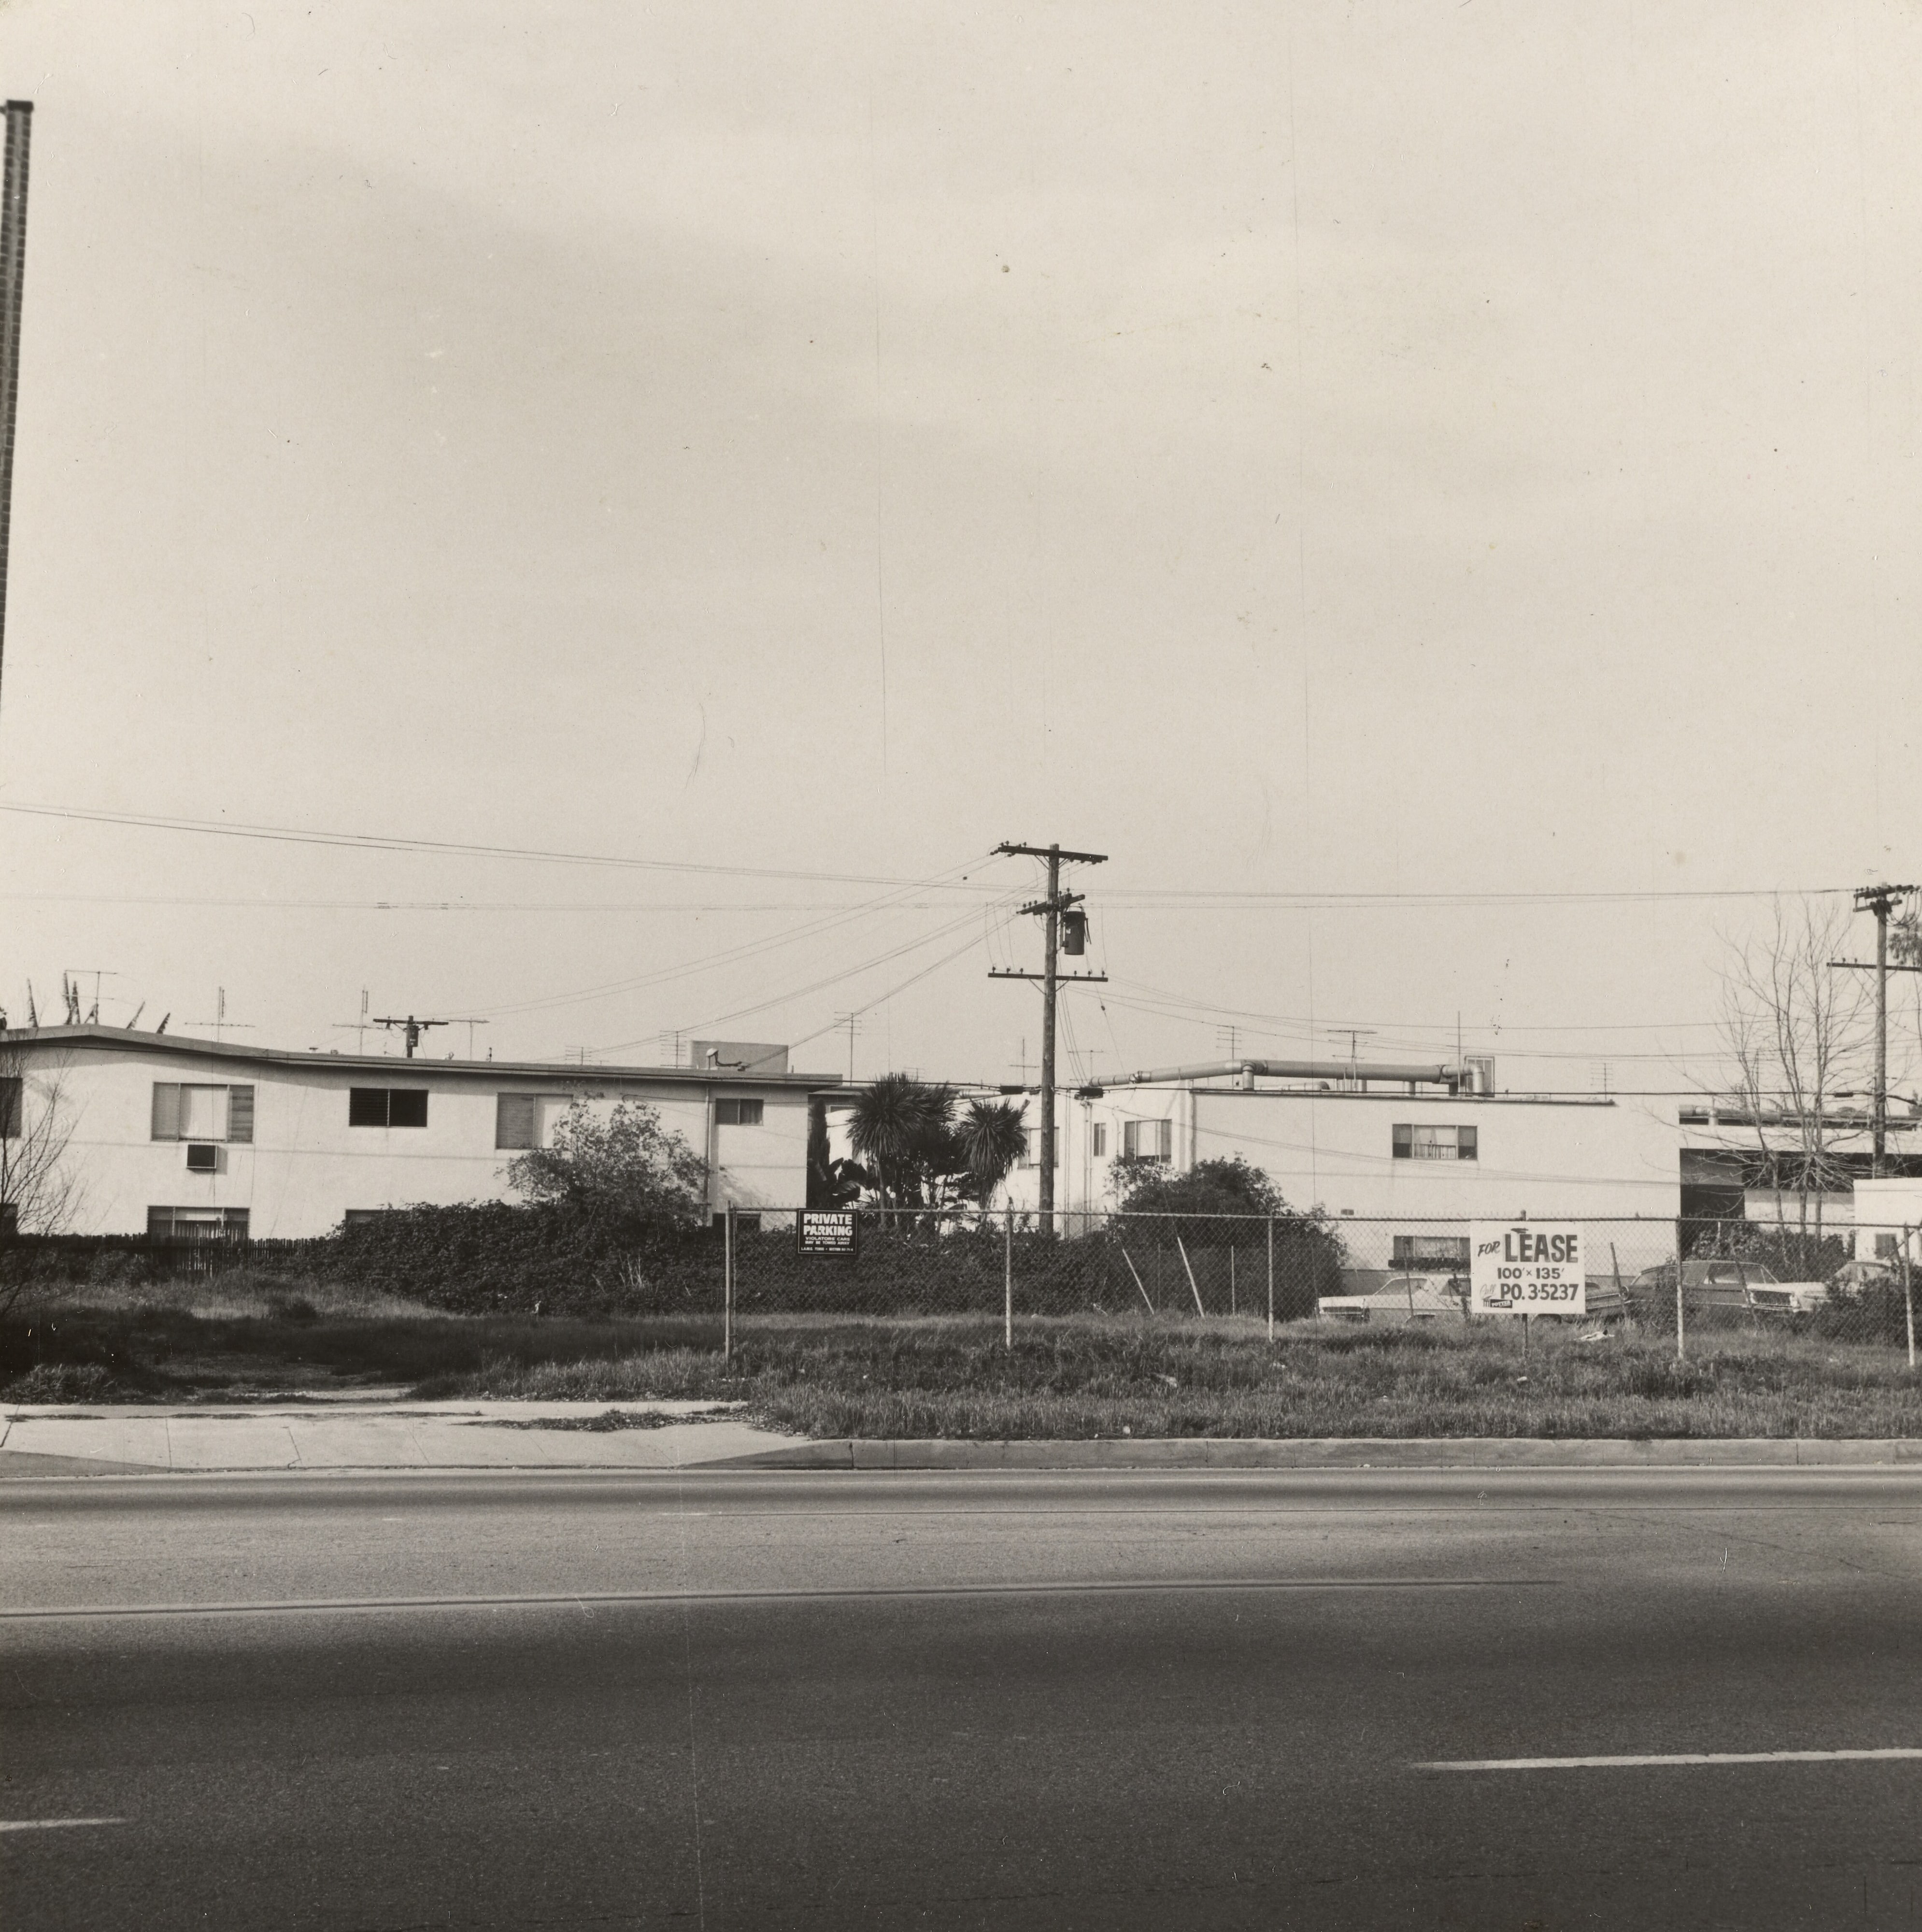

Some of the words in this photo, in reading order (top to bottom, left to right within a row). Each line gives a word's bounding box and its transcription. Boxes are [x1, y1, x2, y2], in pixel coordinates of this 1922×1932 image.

[803, 1213, 852, 1224] PRIVATE
[803, 1225, 853, 1236] PARKING
[1478, 1241, 1500, 1257] FOR
[1505, 1234, 1578, 1263] LEASE
[1500, 1283, 1525, 1300] PO.
